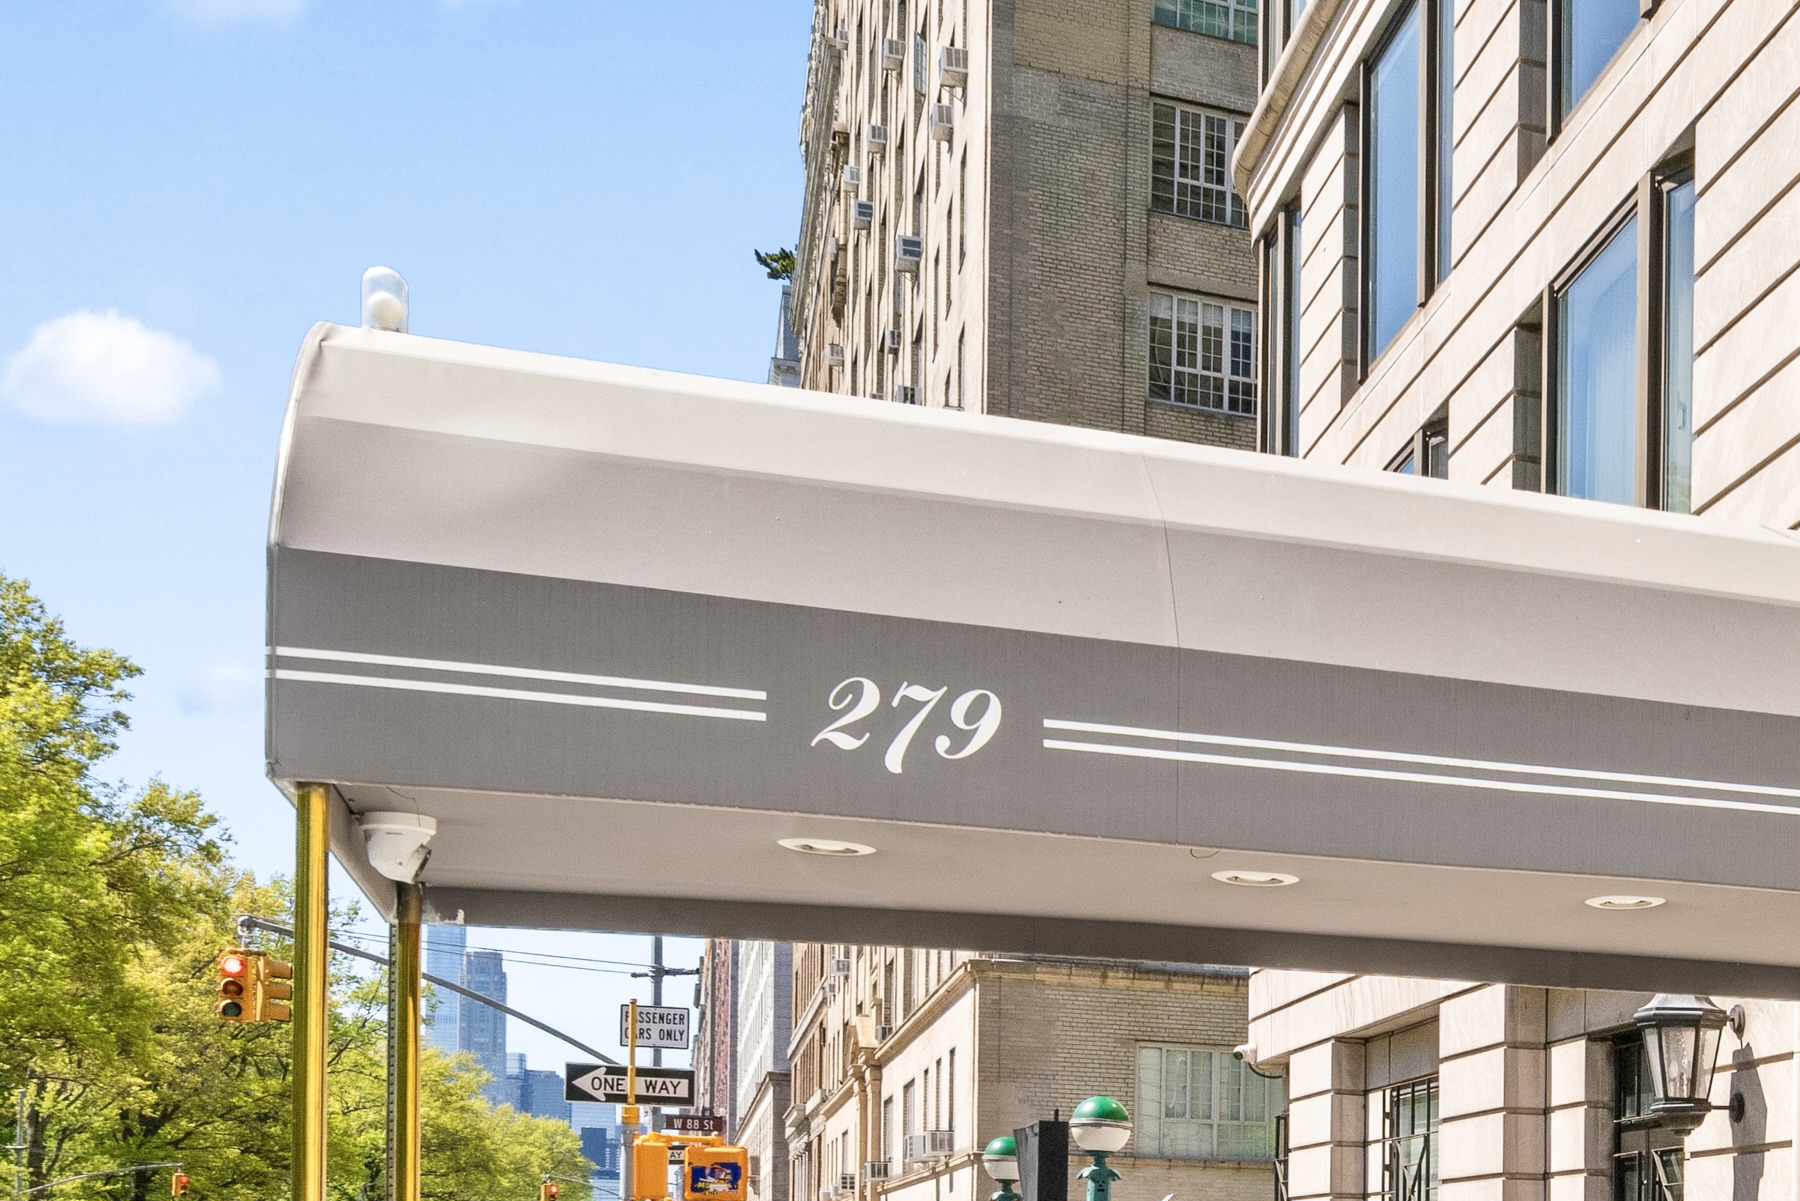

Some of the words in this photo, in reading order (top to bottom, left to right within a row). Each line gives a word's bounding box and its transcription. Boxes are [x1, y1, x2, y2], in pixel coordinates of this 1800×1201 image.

[811, 677, 1002, 774] 279
[625, 1011, 685, 1026] PSSENGER
[625, 1028, 651, 1040] CRS
[659, 1029, 685, 1042] ONLY
[591, 1077, 626, 1092] ONE
[644, 1079, 681, 1095] WAY
[673, 1118, 683, 1129] W
[686, 1119, 700, 1130] 88
[703, 1119, 714, 1130] St
[669, 1151, 682, 1159] AY
